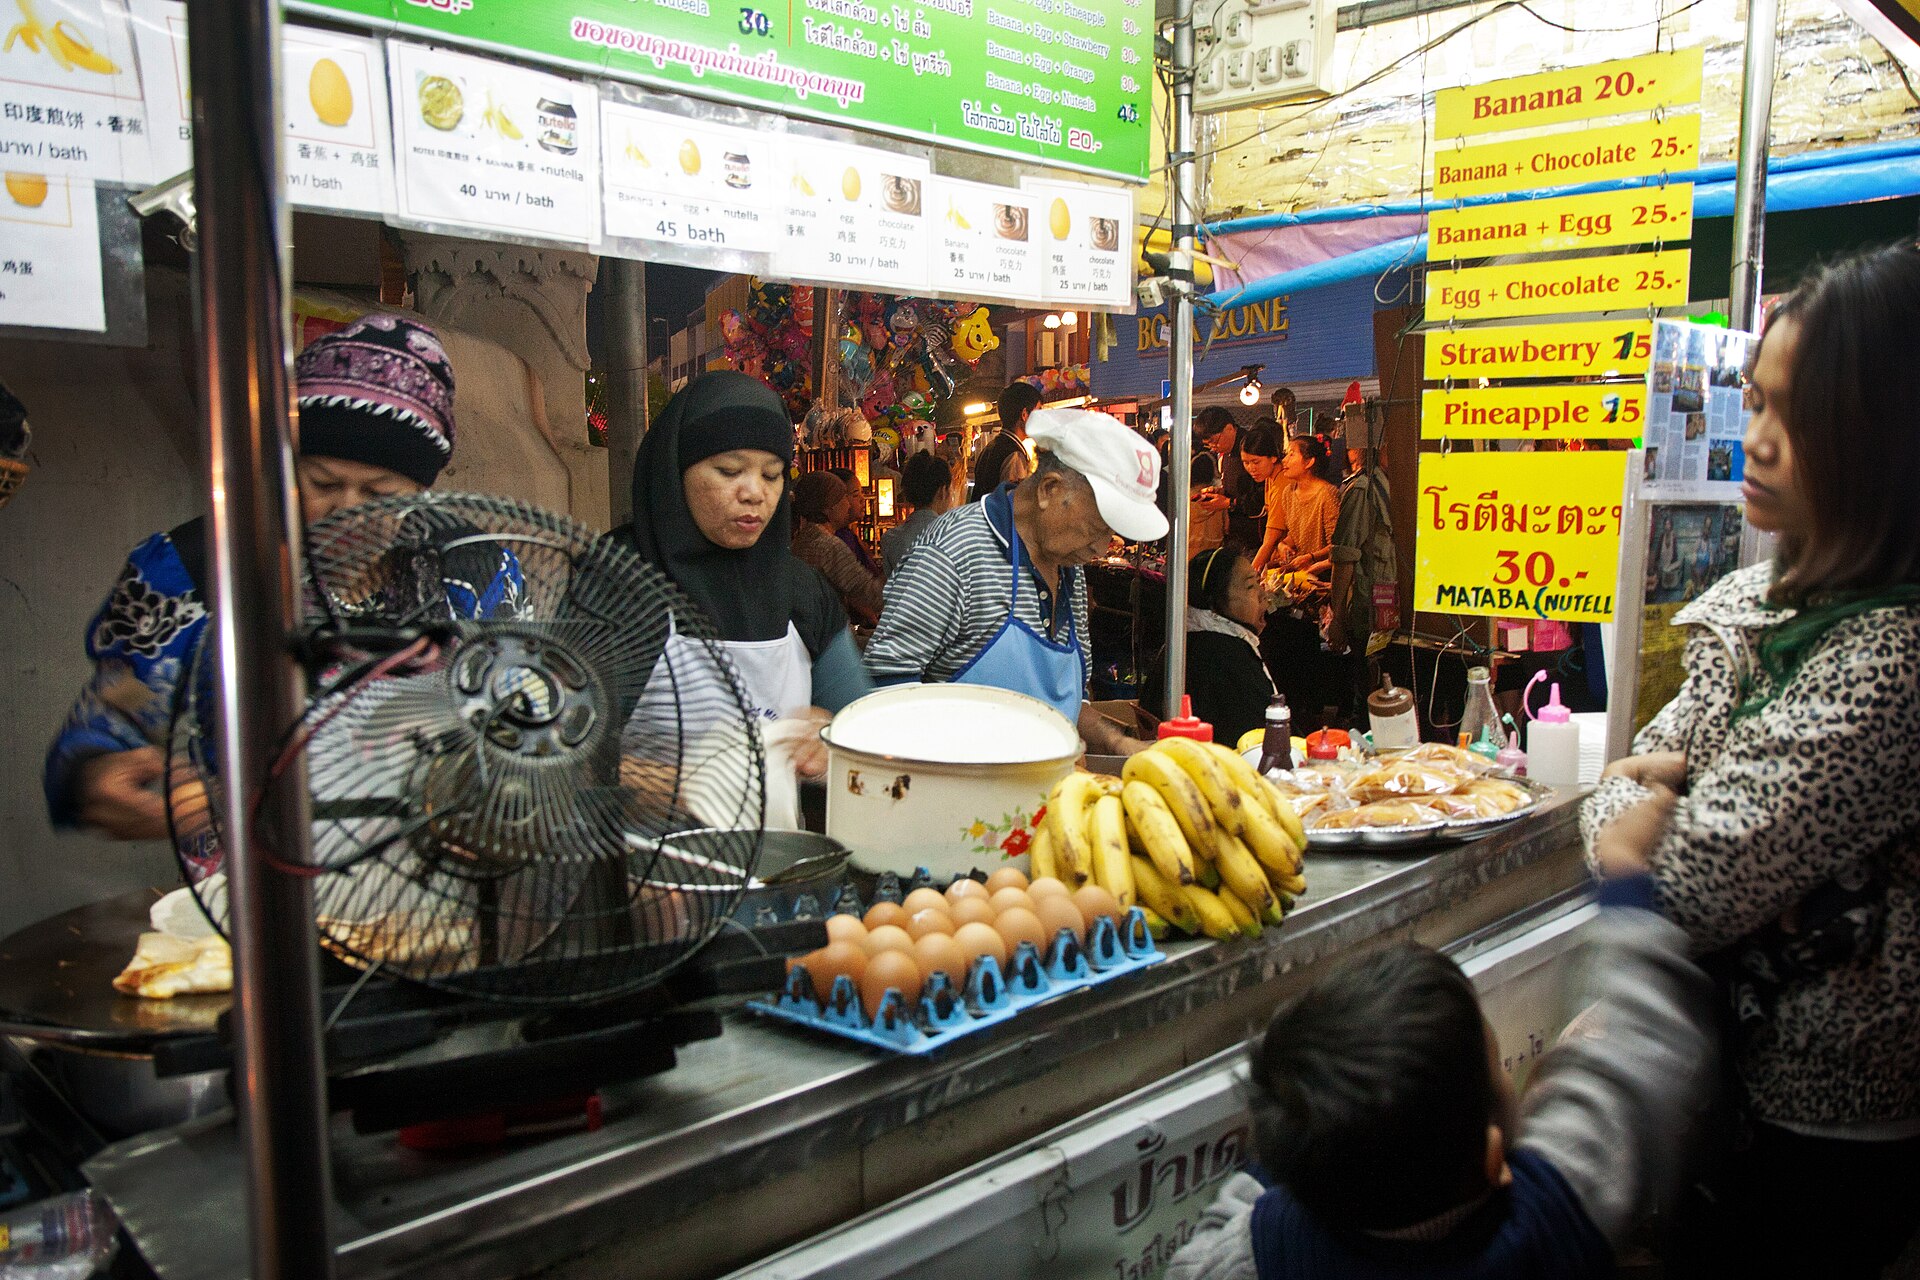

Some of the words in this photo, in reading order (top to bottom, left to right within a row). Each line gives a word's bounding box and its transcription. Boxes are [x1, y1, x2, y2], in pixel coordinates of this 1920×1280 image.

[1064, 3, 1105, 26] Pineapple
[988, 11, 1022, 31] Banana
[1034, 24, 1052, 42] Egg
[1063, 32, 1109, 58] Strawberry
[988, 42, 1022, 62] Banana
[1034, 54, 1052, 72] Egg
[1063, 62, 1094, 82] Orange
[987, 73, 1021, 93] Banana
[1033, 84, 1051, 103] Egg
[1062, 92, 1096, 111] Nuteela
[1472, 85, 1583, 120] Banana
[1594, 71, 1656, 102] 20.-
[107, 114, 144, 136] 香蕉
[50, 142, 89, 162] bath
[298, 143, 329, 161] 香蕉
[1069, 129, 1102, 151] 20.-
[1438, 162, 1508, 186] Banana
[1513, 161, 1524, 176] +
[1530, 143, 1637, 174] Chocolate
[1650, 136, 1694, 161] 25.-
[312, 174, 343, 191] bath
[459, 182, 478, 198] 40
[484, 188, 511, 202] บาท
[525, 192, 555, 210] bath
[723, 207, 760, 223] nutella
[1436, 220, 1528, 246] Banana
[1536, 221, 1549, 236] +
[1558, 212, 1613, 237] Egg
[1631, 203, 1688, 227] 25.-
[656, 219, 678, 238] 45
[687, 222, 726, 244] bath
[828, 251, 842, 263] 30
[847, 255, 867, 267] บาท
[877, 257, 900, 270] bath
[1088, 255, 1116, 267] chocolate
[954, 267, 965, 279] 25
[968, 271, 985, 281] บาท
[993, 272, 1012, 284] bath
[1059, 279, 1070, 290] 25
[1072, 282, 1087, 291] บาท
[1093, 282, 1109, 292] bath
[1440, 286, 1481, 310] Egg
[1488, 288, 1498, 302] +
[1505, 273, 1621, 302] Chocolate
[1635, 270, 1682, 291] 25.-
[1440, 339, 1601, 367] Strawberry
[1443, 400, 1590, 431] Pineapple
[1493, 549, 1590, 588] 30.-
[1436, 584, 1529, 610] MATABA
